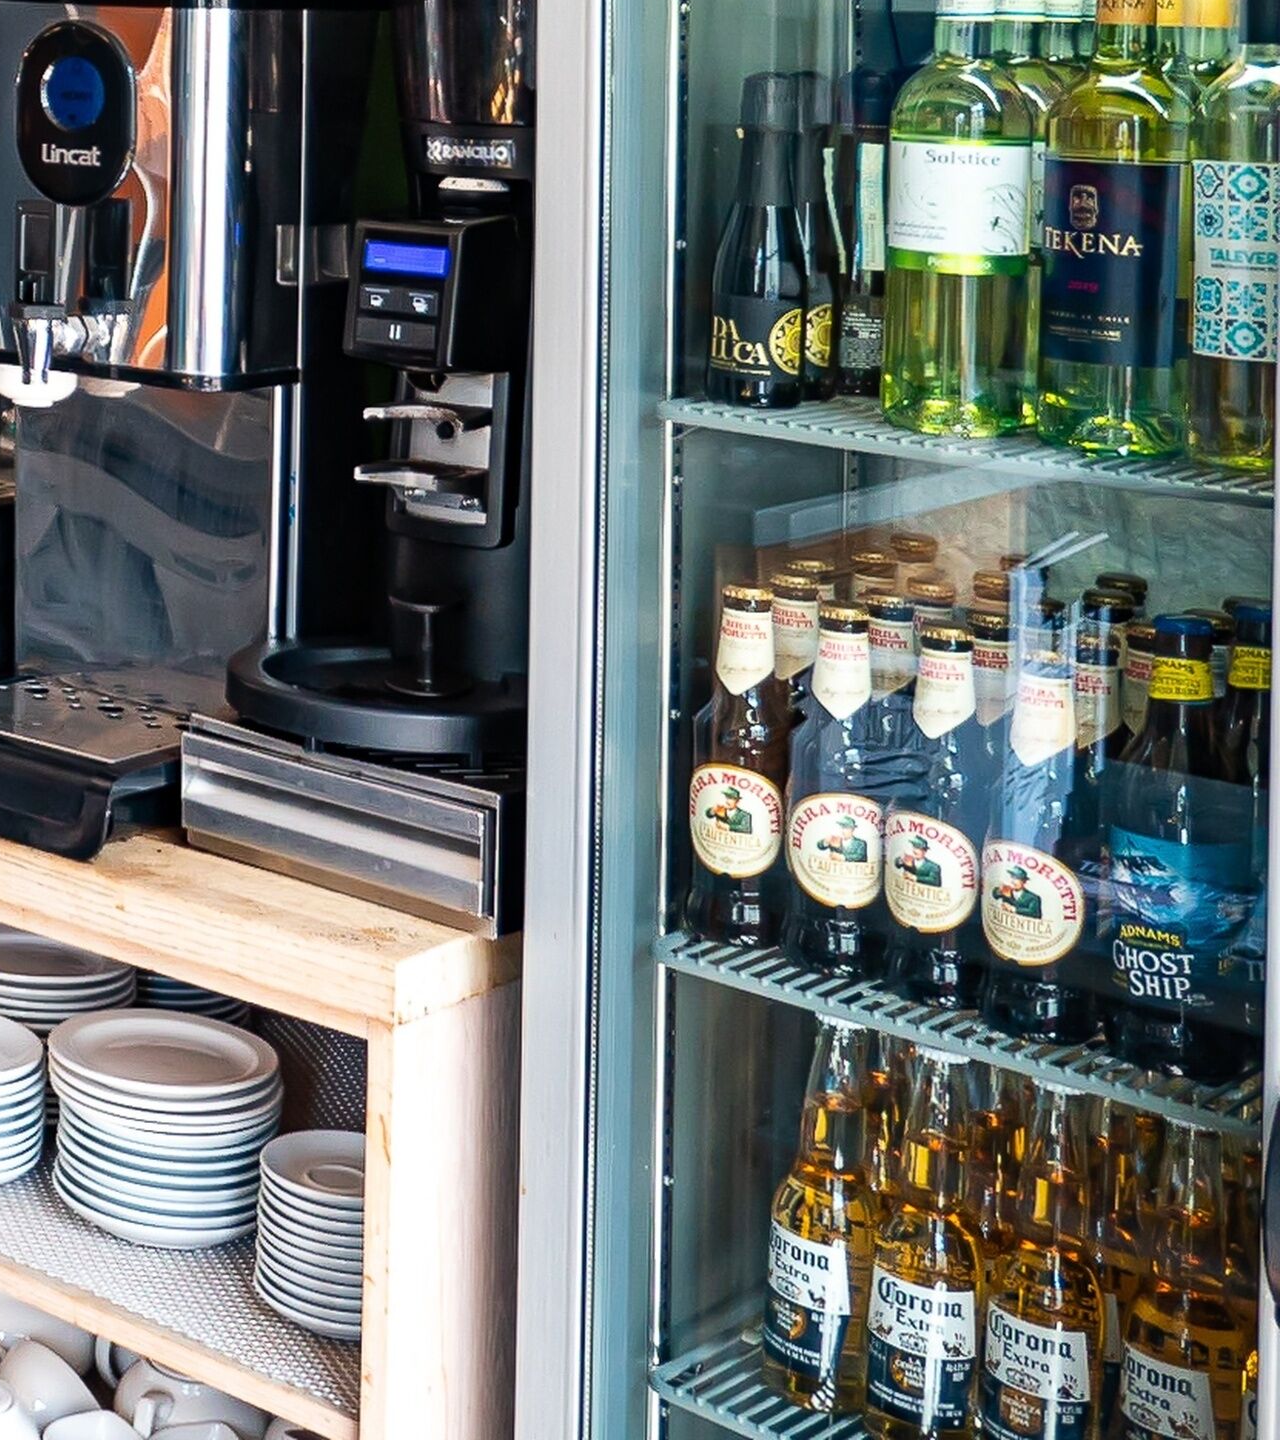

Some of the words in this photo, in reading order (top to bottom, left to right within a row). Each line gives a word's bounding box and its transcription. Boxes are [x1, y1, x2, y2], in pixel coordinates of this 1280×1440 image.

[41, 143, 102, 167] Lincat
[441, 144, 509, 162] RANCILIO
[925, 148, 1001, 167] Solstice
[1045, 227, 1145, 259] TEKENA
[1209, 247, 1278, 266] TALEVER
[713, 316, 741, 341] DA
[711, 336, 771, 367] LUCA
[721, 772, 782, 835] MORETTI
[792, 803, 831, 851] BIRRA
[908, 819, 976, 891] MORETTI
[1006, 848, 1078, 923] MORETTI
[1120, 923, 1182, 948] ADNAMS
[1112, 939, 1195, 976] GHOST
[1129, 971, 1192, 1001] SHIP
[775, 1253, 810, 1283] Extra
[877, 1275, 966, 1320] Corona
[989, 1309, 1076, 1362] Corona
[1002, 1342, 1051, 1375] Extra
[1126, 1376, 1172, 1411] Extra
